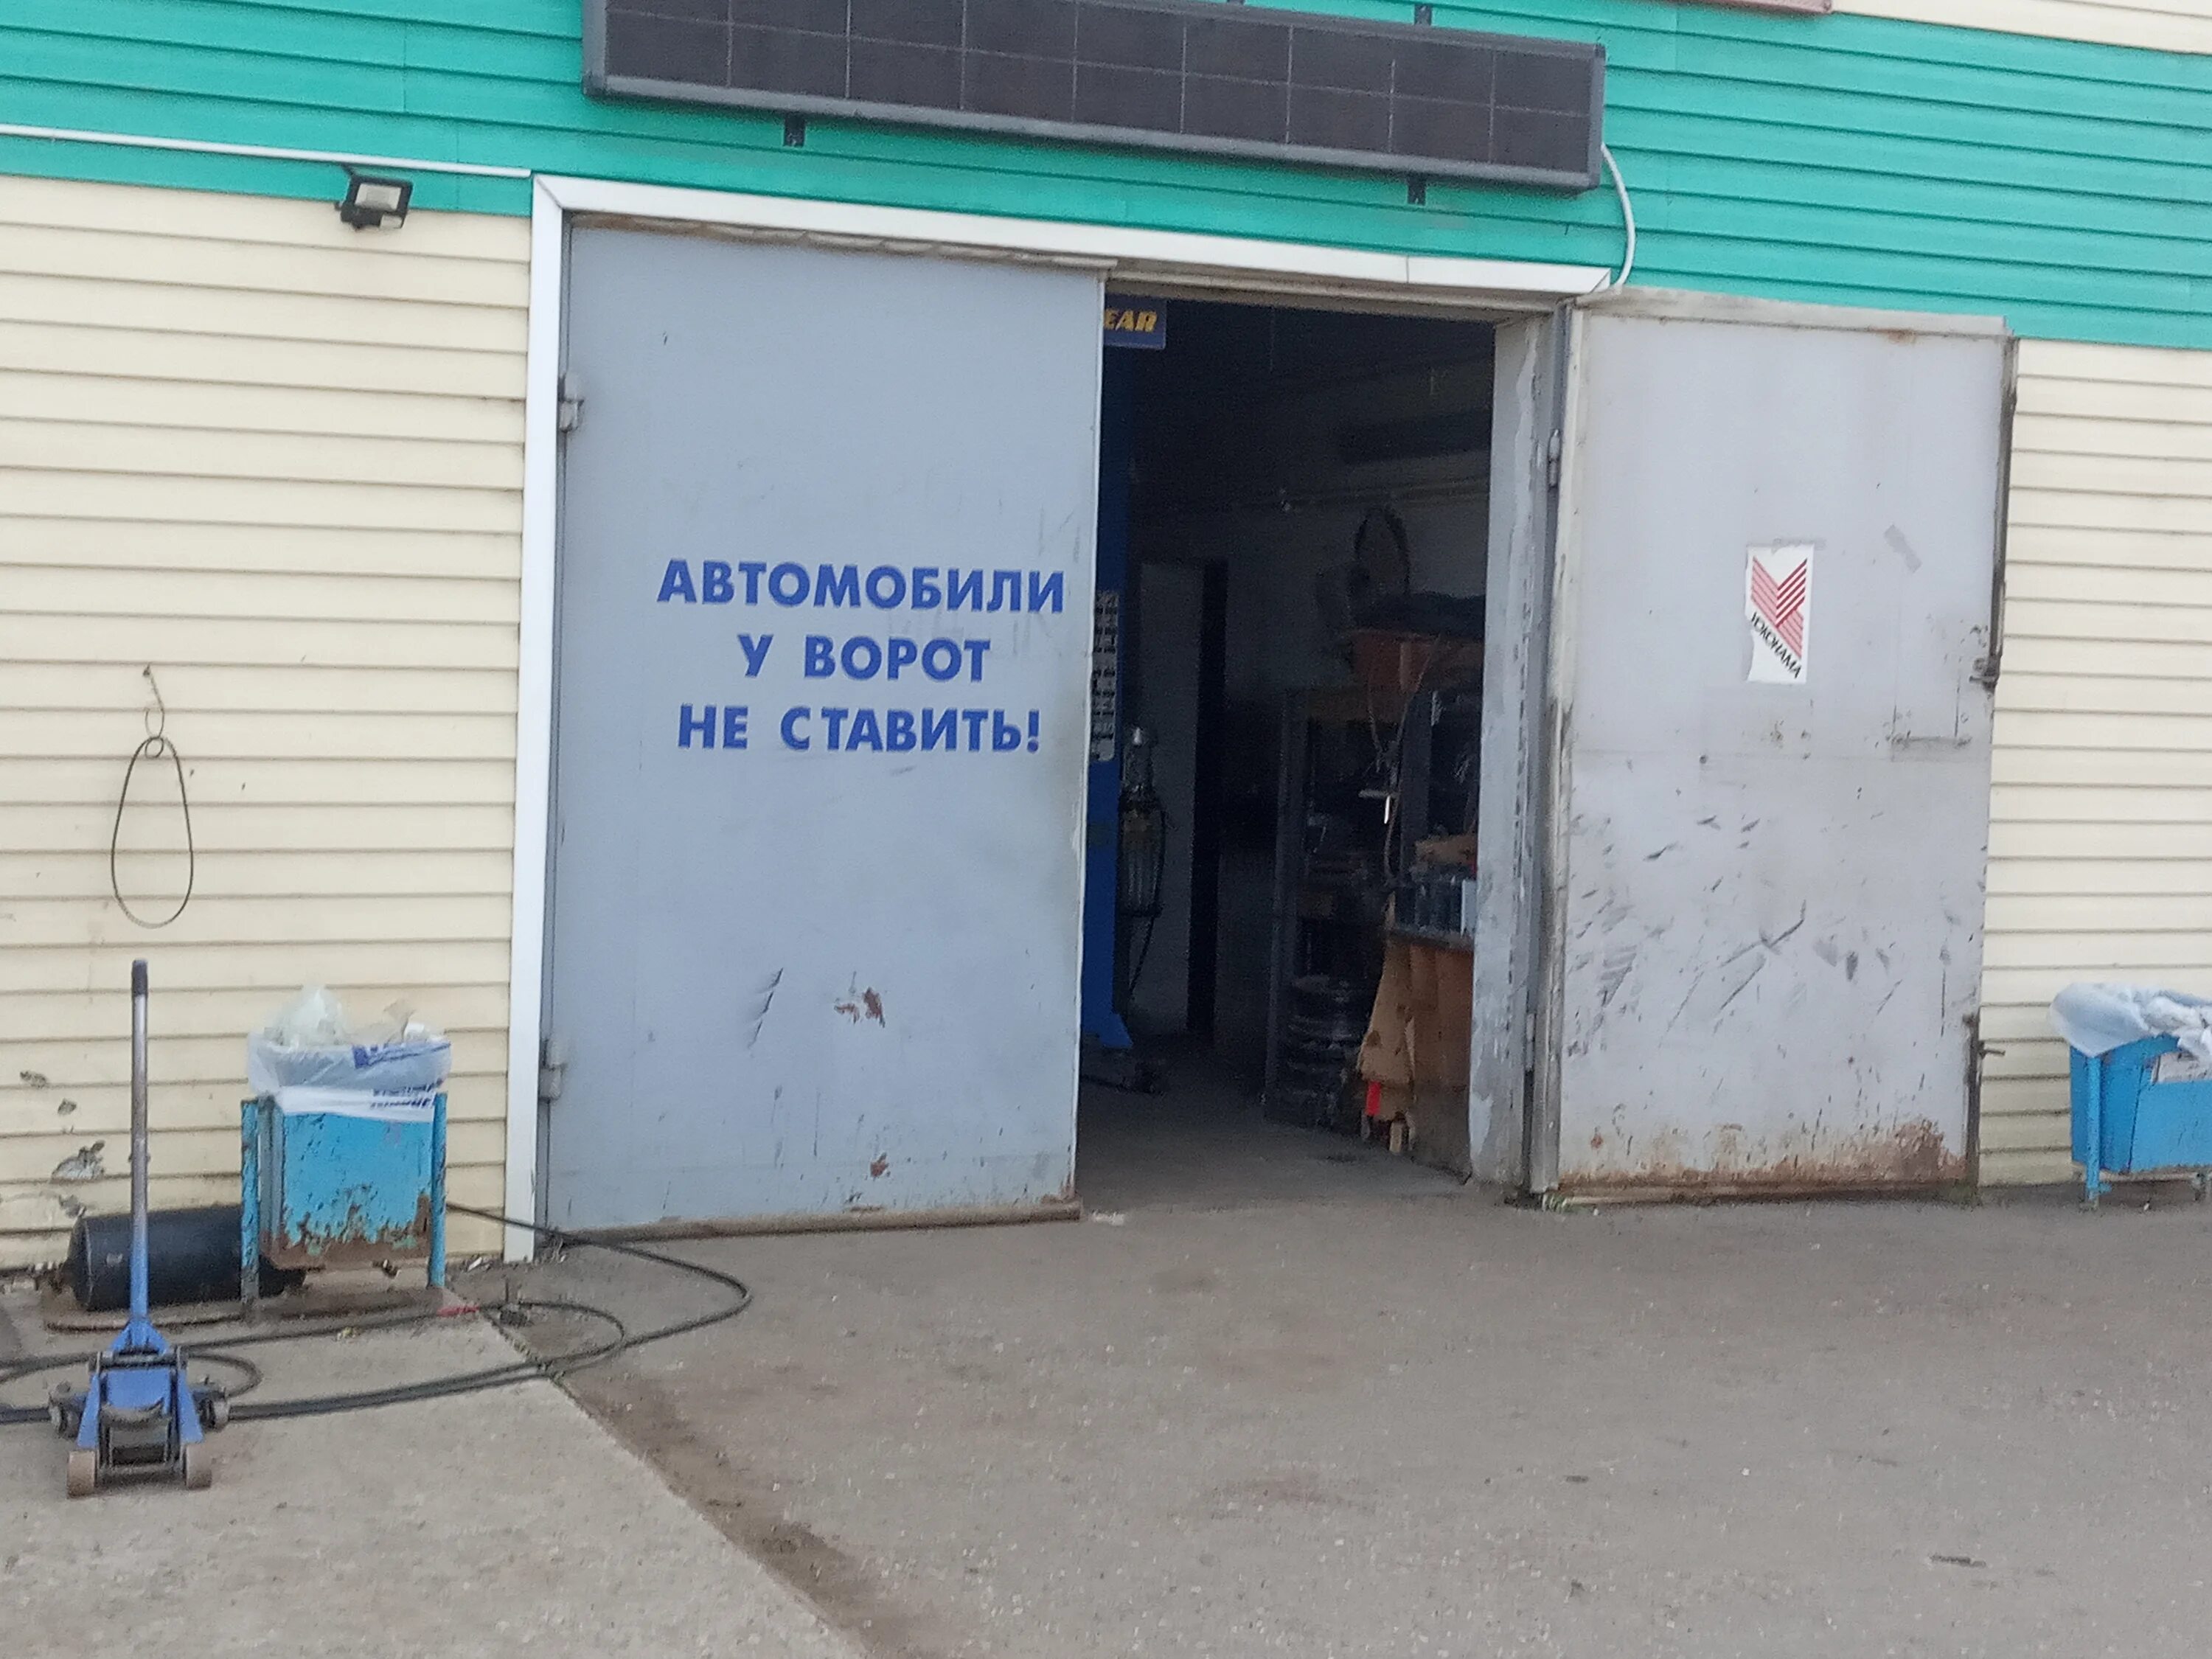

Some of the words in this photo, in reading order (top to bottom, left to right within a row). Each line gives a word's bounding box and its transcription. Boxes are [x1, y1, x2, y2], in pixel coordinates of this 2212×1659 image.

[657, 559, 1064, 613] АВТОМОБИЛИ
[737, 633, 774, 678] У
[804, 635, 992, 682] ВОРОТ
[677, 704, 749, 750] НЕ
[779, 706, 1040, 753] СТАВИТЬ!
